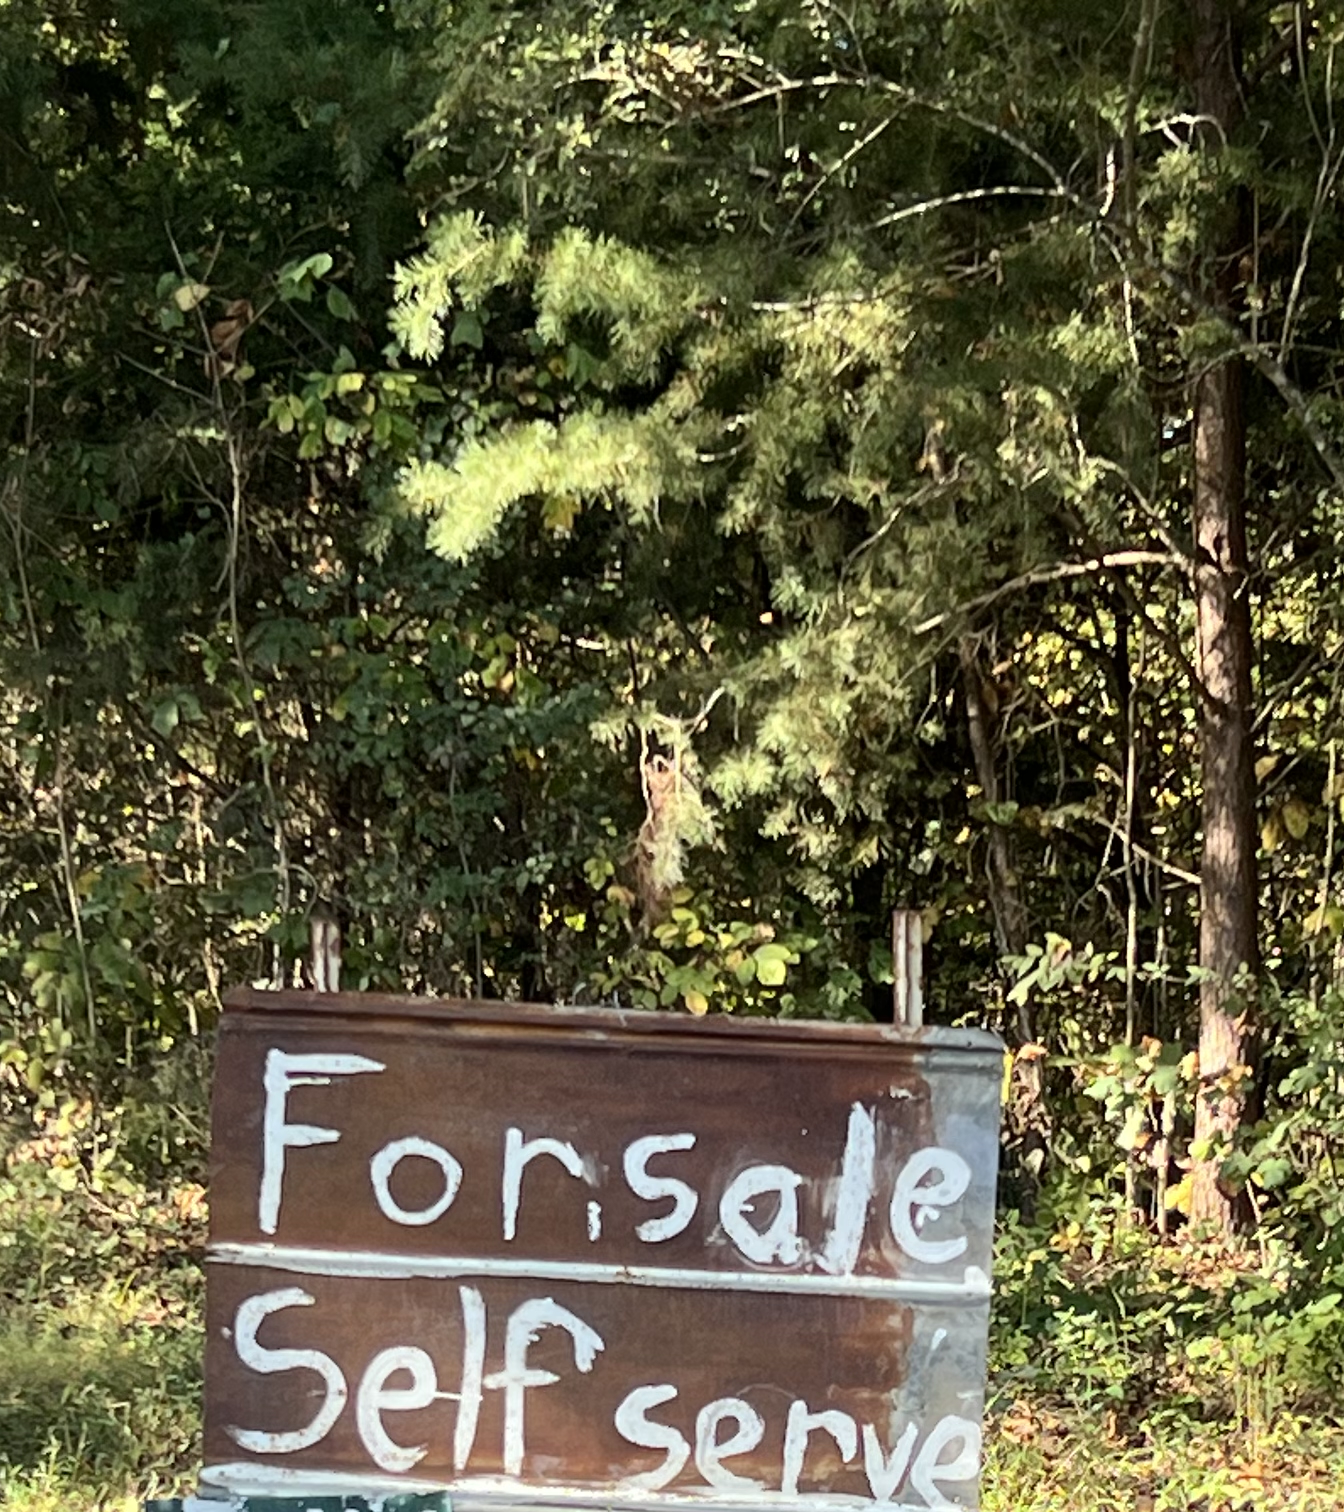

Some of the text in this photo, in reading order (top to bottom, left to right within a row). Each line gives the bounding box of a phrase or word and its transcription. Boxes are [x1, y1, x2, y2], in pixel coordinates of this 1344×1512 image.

[623, 1101, 972, 1273] sale
[227, 1286, 982, 1508] Self serve
